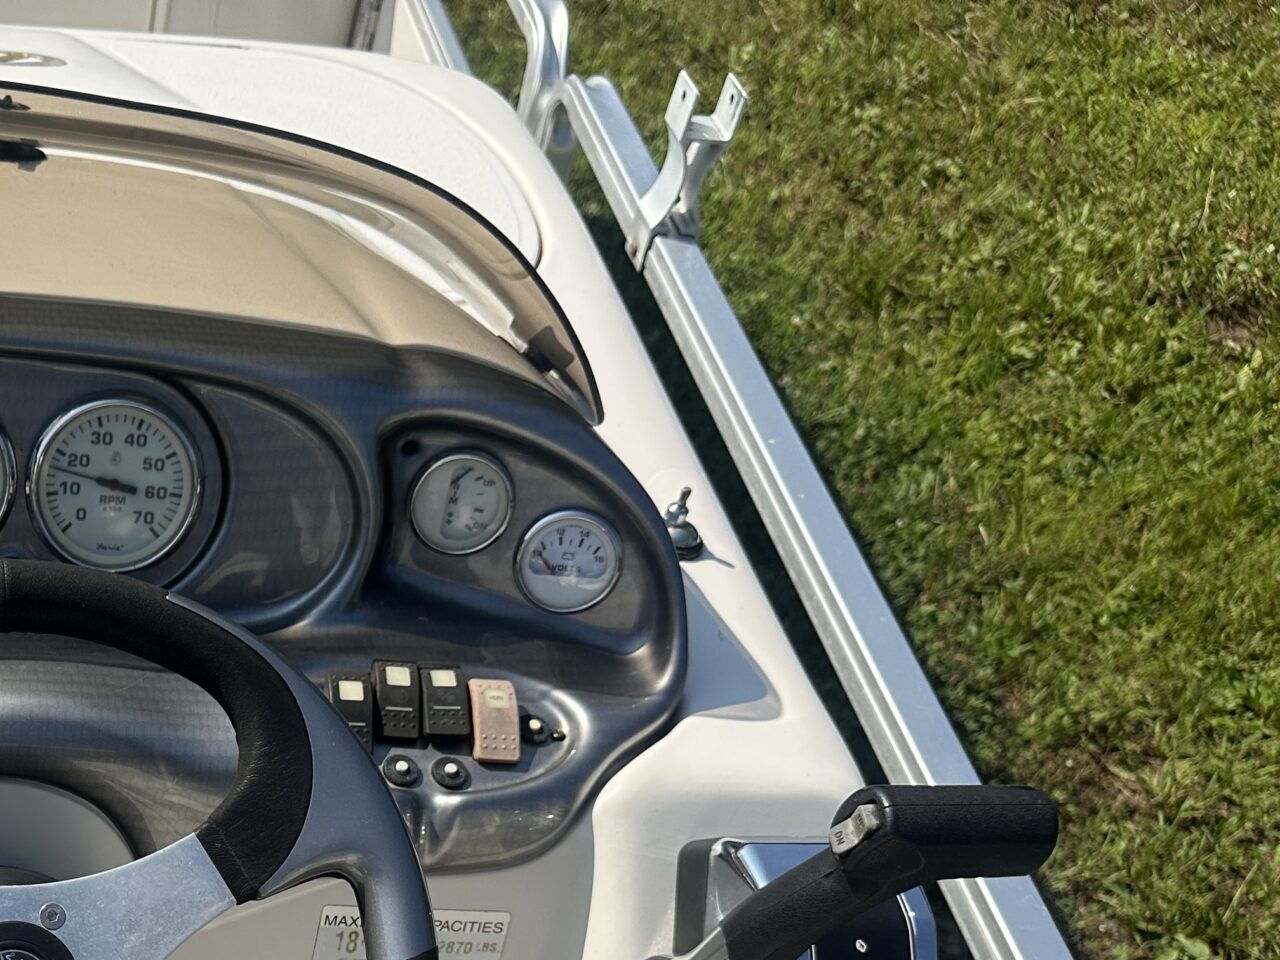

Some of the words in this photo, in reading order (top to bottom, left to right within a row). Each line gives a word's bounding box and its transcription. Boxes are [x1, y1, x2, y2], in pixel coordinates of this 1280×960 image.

[91, 432, 113, 445] 30
[124, 433, 147, 447] 40
[68, 454, 90, 467] 20
[143, 458, 165, 471] 50
[60, 482, 80, 495] 10
[145, 486, 167, 499] 60
[99, 495, 126, 505] RPM
[76, 508, 87, 521] 0
[133, 511, 154, 524] 70
[556, 528, 566, 537] 12
[580, 530, 590, 538] 14
[594, 555, 604, 563] 16
[552, 564, 581, 572] VOLTS
[834, 830, 846, 846] DN
[324, 915, 362, 928] MAX
[433, 920, 504, 934] PACITIES
[336, 930, 359, 954] 18
[438, 941, 473, 955] 2870
